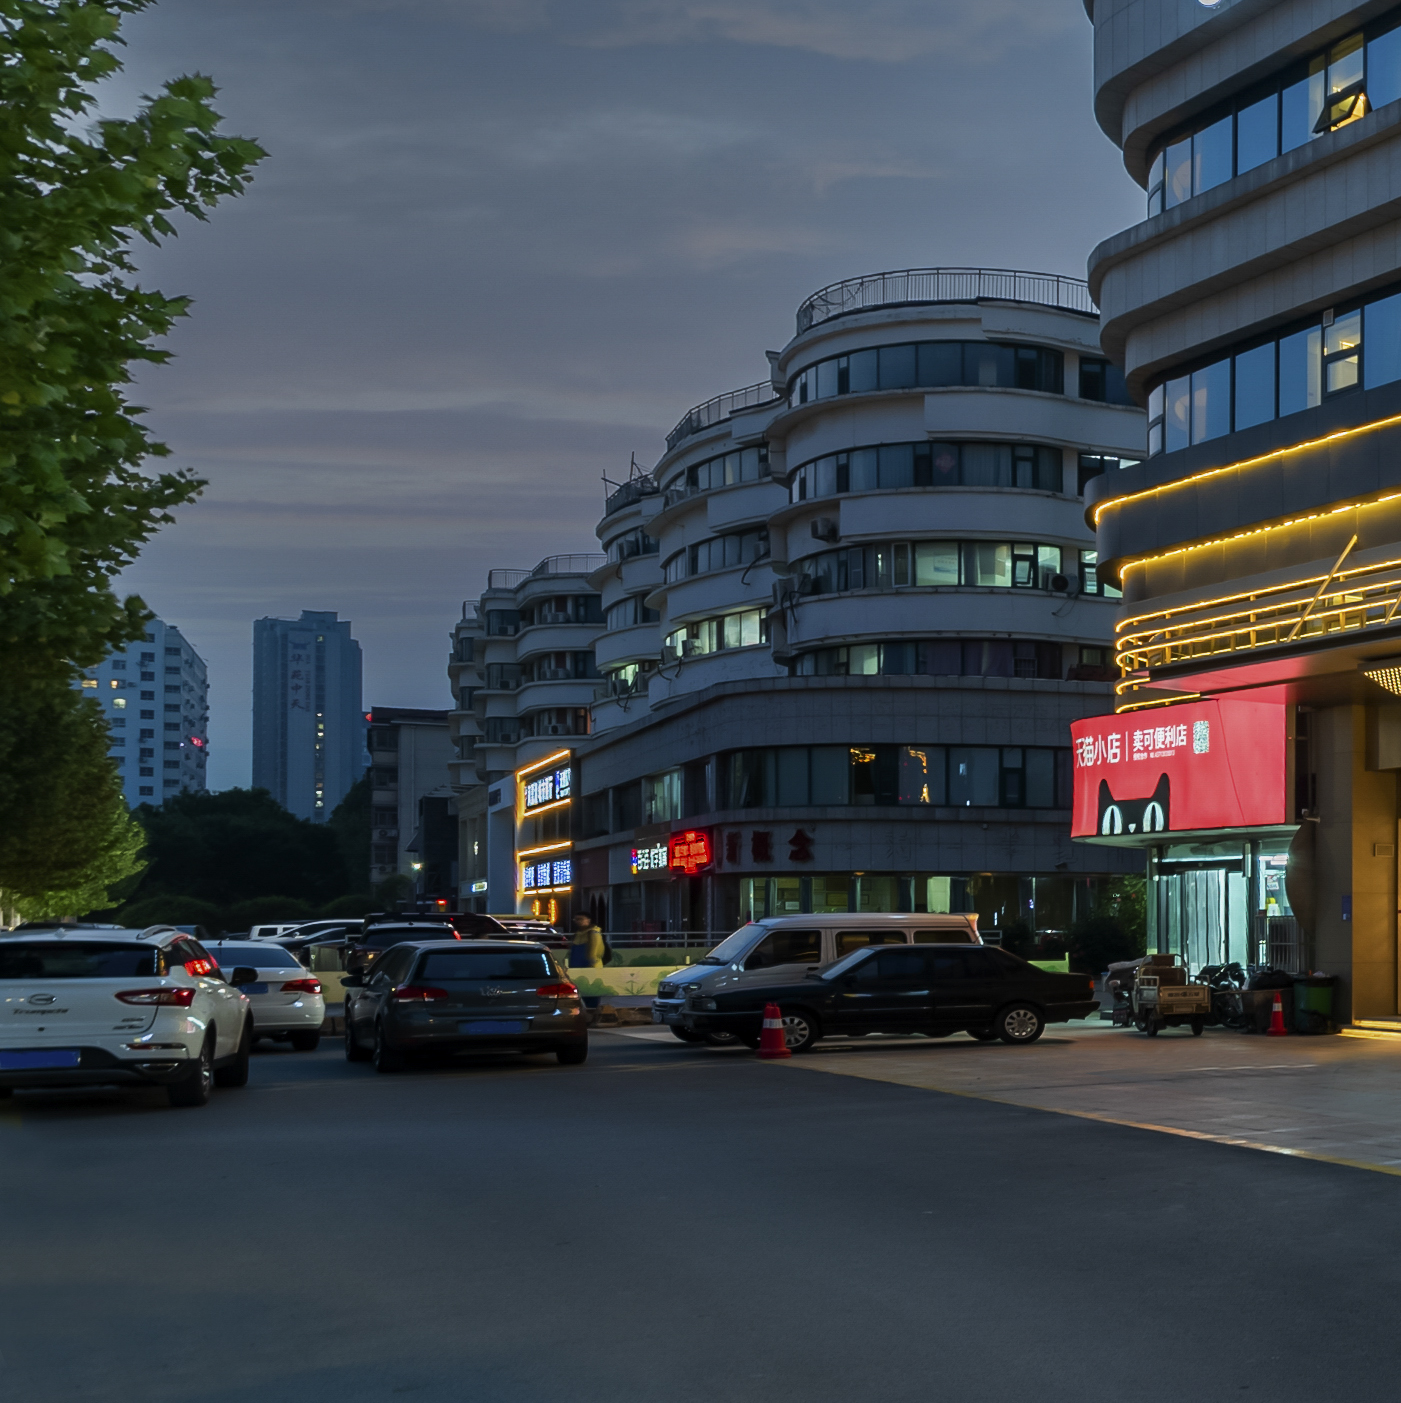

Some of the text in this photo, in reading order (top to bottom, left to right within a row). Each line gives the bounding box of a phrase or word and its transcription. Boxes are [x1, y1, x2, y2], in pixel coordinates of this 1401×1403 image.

[1075, 732, 1121, 769] 天猫小店
[1132, 723, 1188, 753] 卖可便利店
